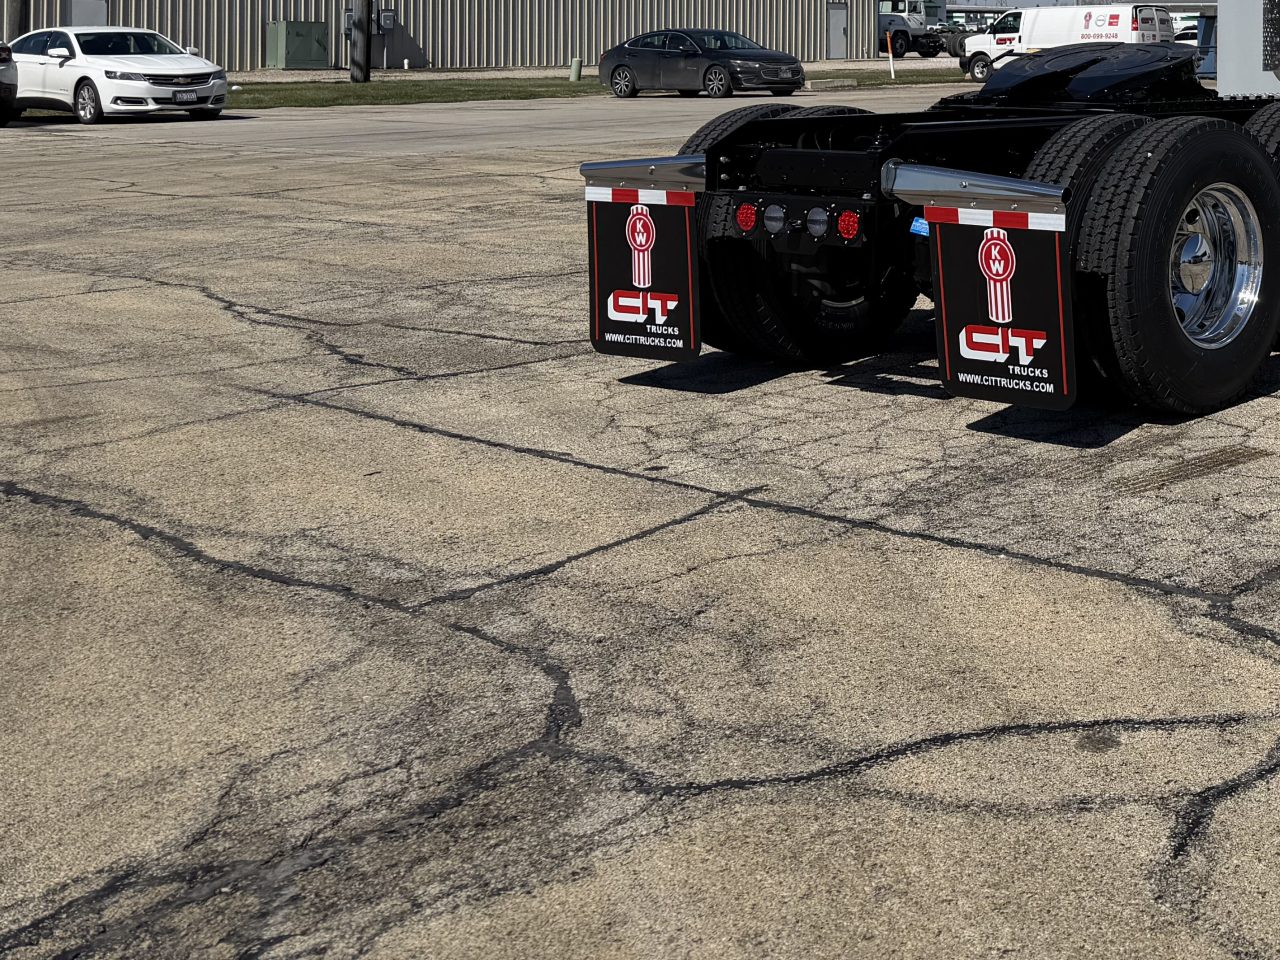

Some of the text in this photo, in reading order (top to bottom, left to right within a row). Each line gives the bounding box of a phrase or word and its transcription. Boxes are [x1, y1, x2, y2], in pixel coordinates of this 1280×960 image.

[607, 290, 679, 324] CIT
[646, 324, 679, 335] TRUCKS
[604, 332, 684, 348] WWW.CITTRUCKS.COM
[959, 324, 1047, 366] CIT
[1007, 365, 1049, 378] TRUCKS
[958, 372, 1054, 393] WWW.CITTRUCKS.COM
